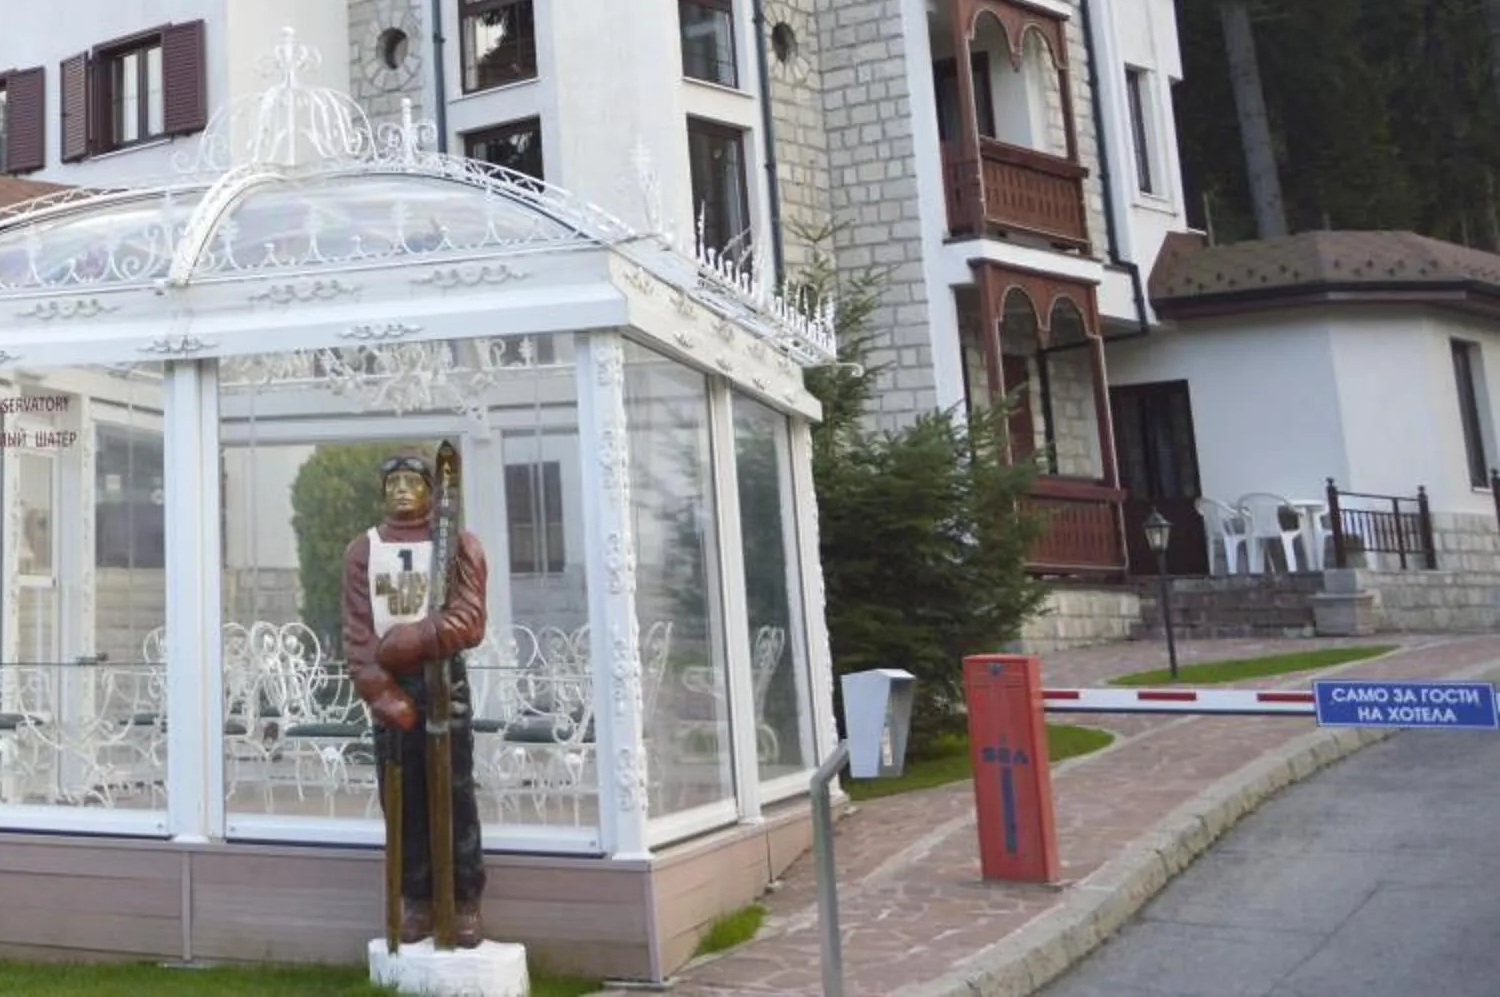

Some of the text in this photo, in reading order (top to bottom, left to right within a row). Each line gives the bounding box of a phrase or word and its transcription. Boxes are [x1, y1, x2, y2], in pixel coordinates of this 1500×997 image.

[397, 548, 413, 571] 1
[1331, 687, 1480, 705] САМО ЗА ГОСТИ
[1357, 706, 1457, 723] НА ХОТЕЛА
